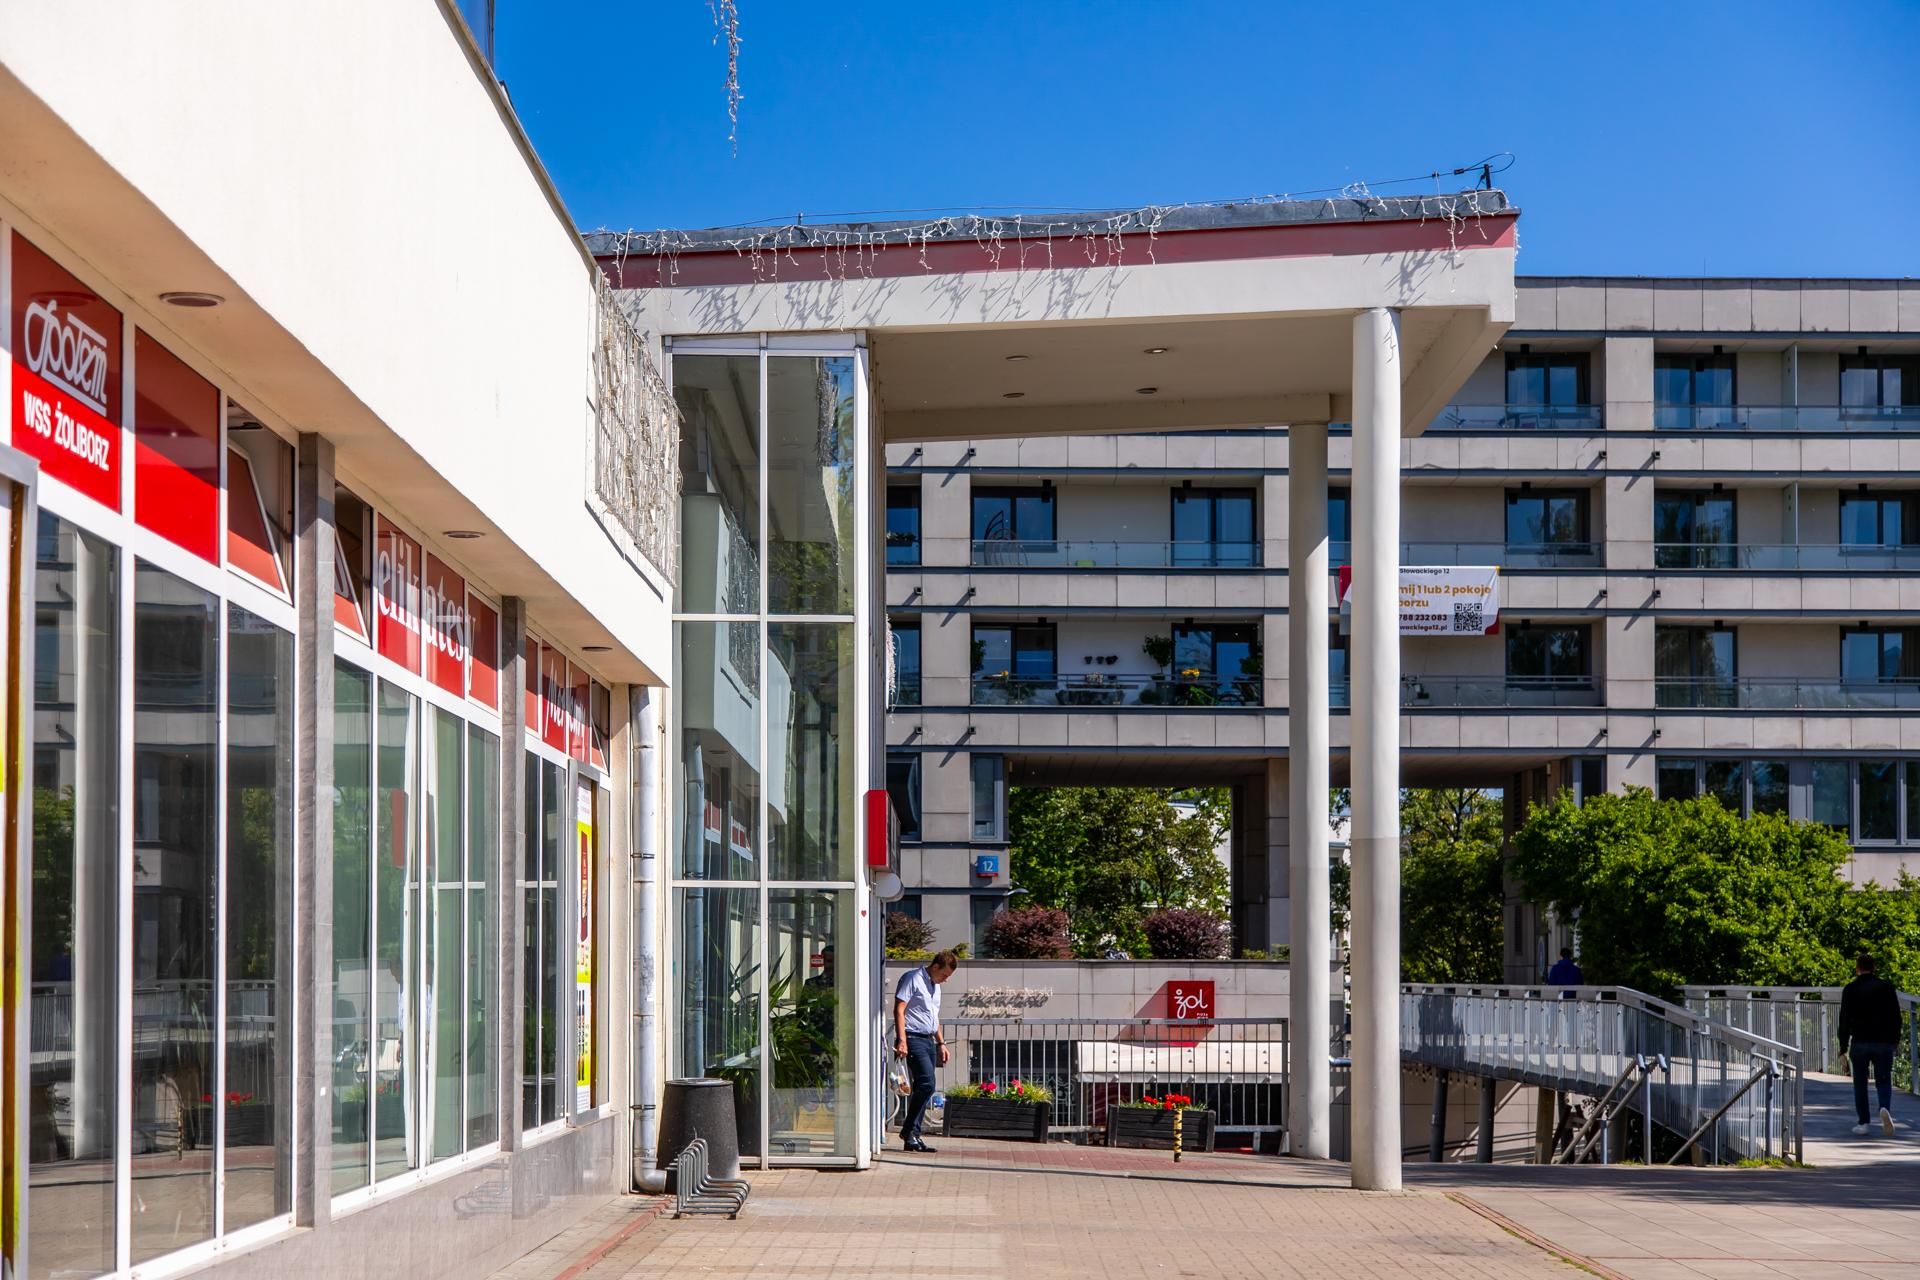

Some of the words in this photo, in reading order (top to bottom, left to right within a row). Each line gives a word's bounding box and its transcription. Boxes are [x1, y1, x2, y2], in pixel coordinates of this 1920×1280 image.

[23, 390, 52, 438] WSS
[54, 401, 110, 471] ŻOLIBORZ
[1417, 585, 1422, 594] 1
[1424, 585, 1442, 594] lub
[1444, 585, 1451, 594] 2
[983, 860, 993, 872] 12
